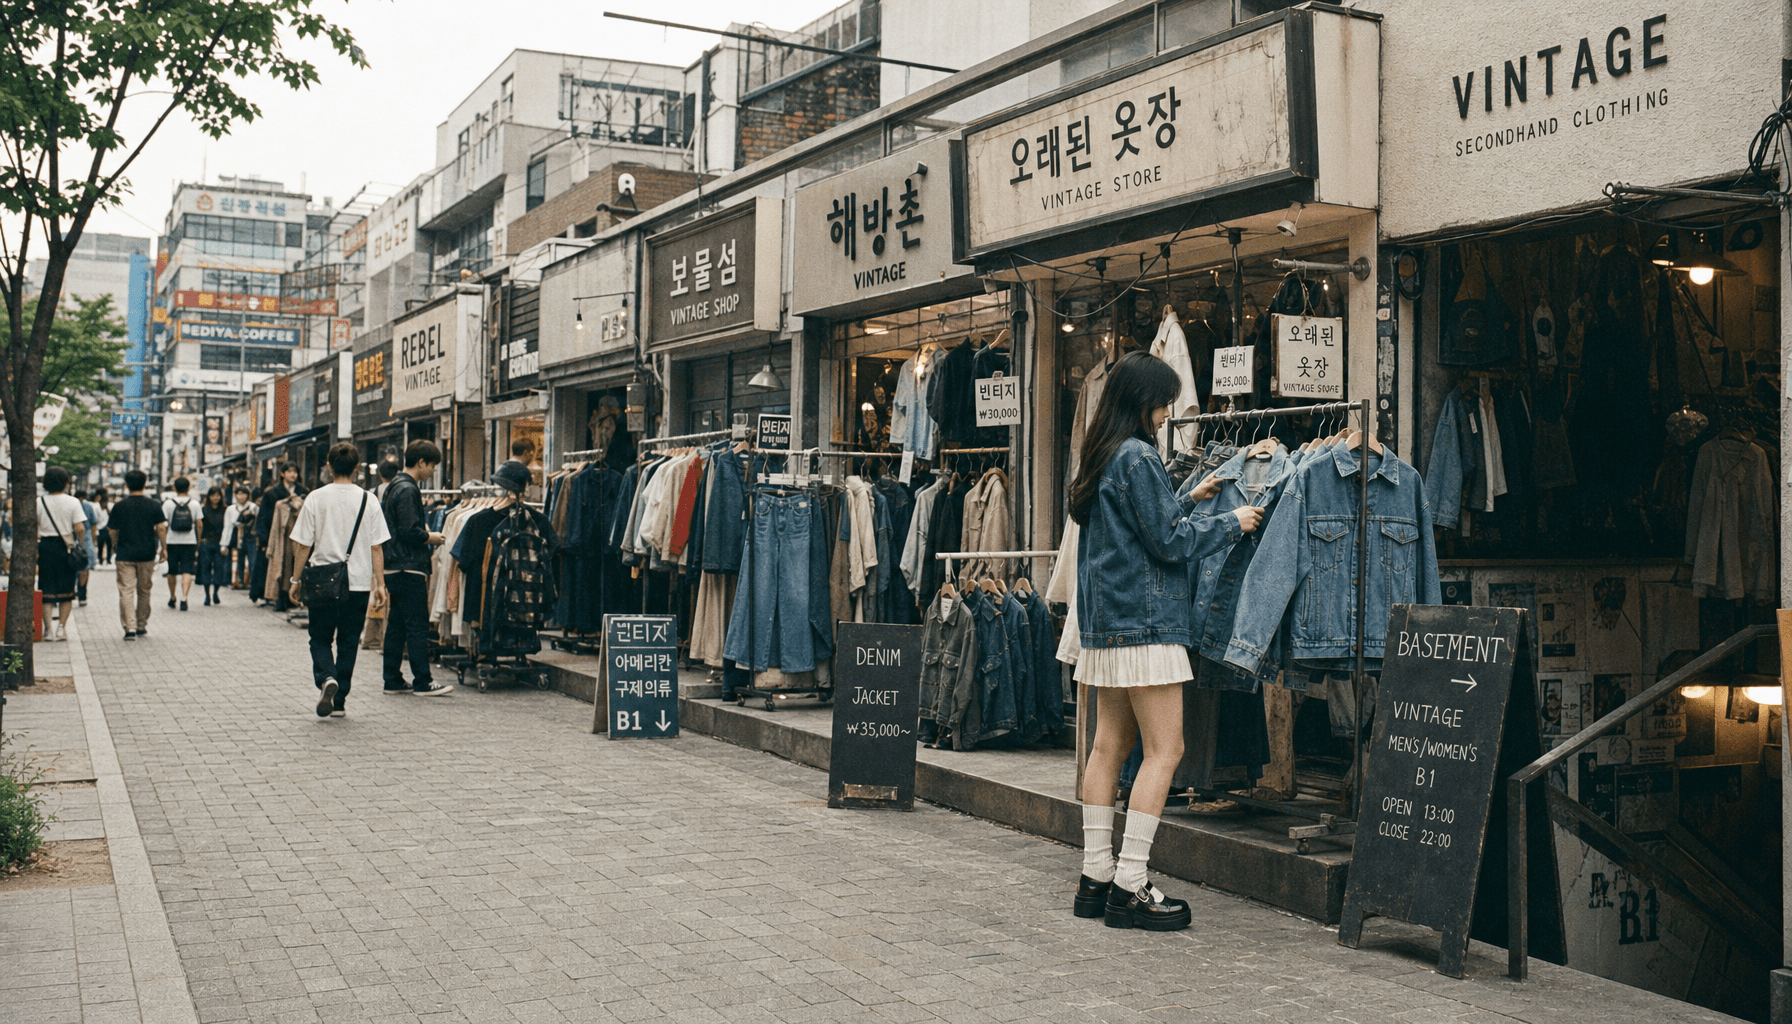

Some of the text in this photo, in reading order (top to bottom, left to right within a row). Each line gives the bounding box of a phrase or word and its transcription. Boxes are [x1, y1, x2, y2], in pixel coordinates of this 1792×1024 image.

[1452, 13, 1669, 119] VINTAGE
[1009, 85, 1182, 186] 오래된 옷장
[1455, 88, 1670, 157] SECONDHAND CLOTHING
[1041, 164, 1163, 211] VINTAGE STORE
[827, 178, 925, 261] 해방촌
[669, 238, 737, 298] 보물섬
[853, 260, 906, 290] VINTAGE
[670, 293, 740, 326] VINTAGE SHOP
[238, 327, 295, 342] COFFEE
[401, 322, 446, 370] REBEL
[1288, 324, 1335, 347] 오래된
[404, 365, 442, 392] VINTAGE
[1297, 356, 1329, 379] 옷장
[979, 382, 1017, 401] 빈티지
[979, 407, 1018, 420] ₩30,000
[856, 646, 901, 667] DENIM
[1397, 631, 1505, 663] BASEMENT
[614, 653, 672, 673] 아메리칸
[614, 679, 673, 698] 구제의류
[852, 686, 900, 706] JACKET
[617, 710, 642, 731] B1
[1393, 700, 1464, 728] VINTAGE
[1415, 767, 1436, 788] B1
[1382, 796, 1455, 824] OPEN 13:00
[1378, 821, 1452, 848] CLOSE 22:00
[1618, 886, 1660, 946] B1
